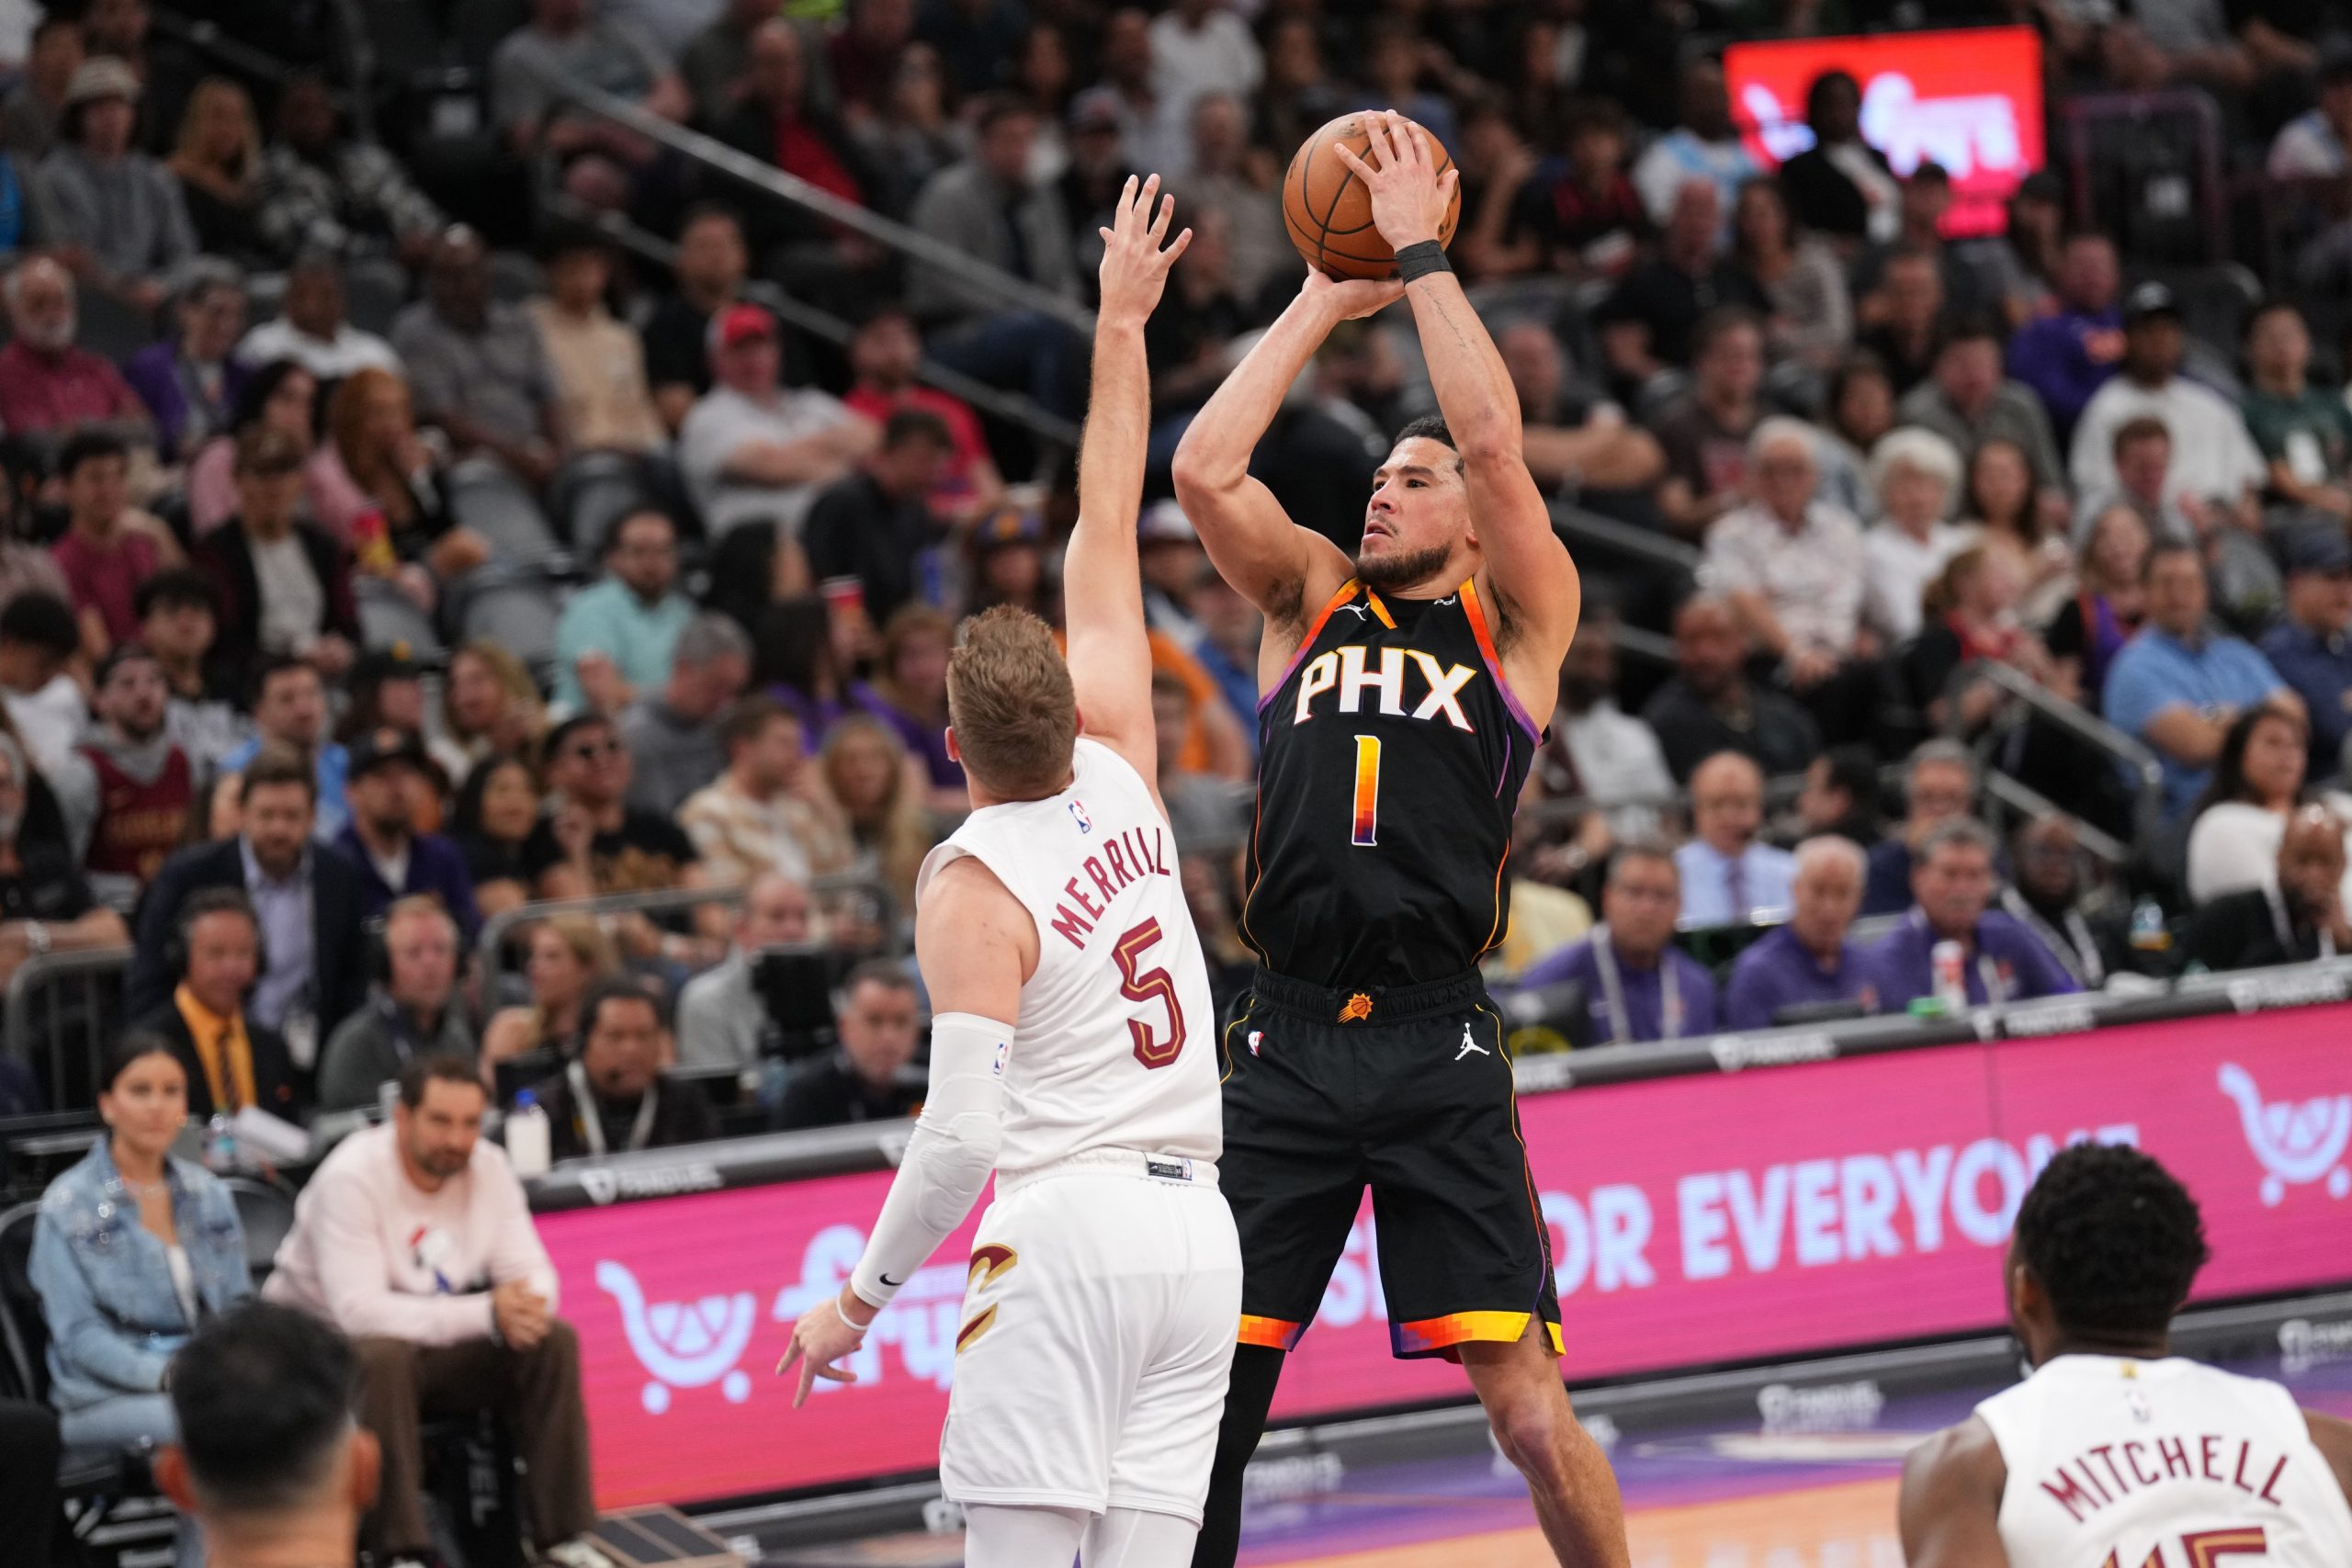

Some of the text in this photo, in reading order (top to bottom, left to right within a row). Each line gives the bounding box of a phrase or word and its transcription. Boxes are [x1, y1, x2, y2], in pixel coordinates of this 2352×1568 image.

[1294, 645, 1477, 734] PHX
[1351, 734, 1381, 847] 1
[1051, 826, 1170, 951] MERRILL
[1111, 915, 1187, 1070] 5
[1535, 1184, 1657, 1297] OR
[1677, 1122, 2140, 1281] EVERYO
[2039, 1433, 2289, 1524] MITCHELL
